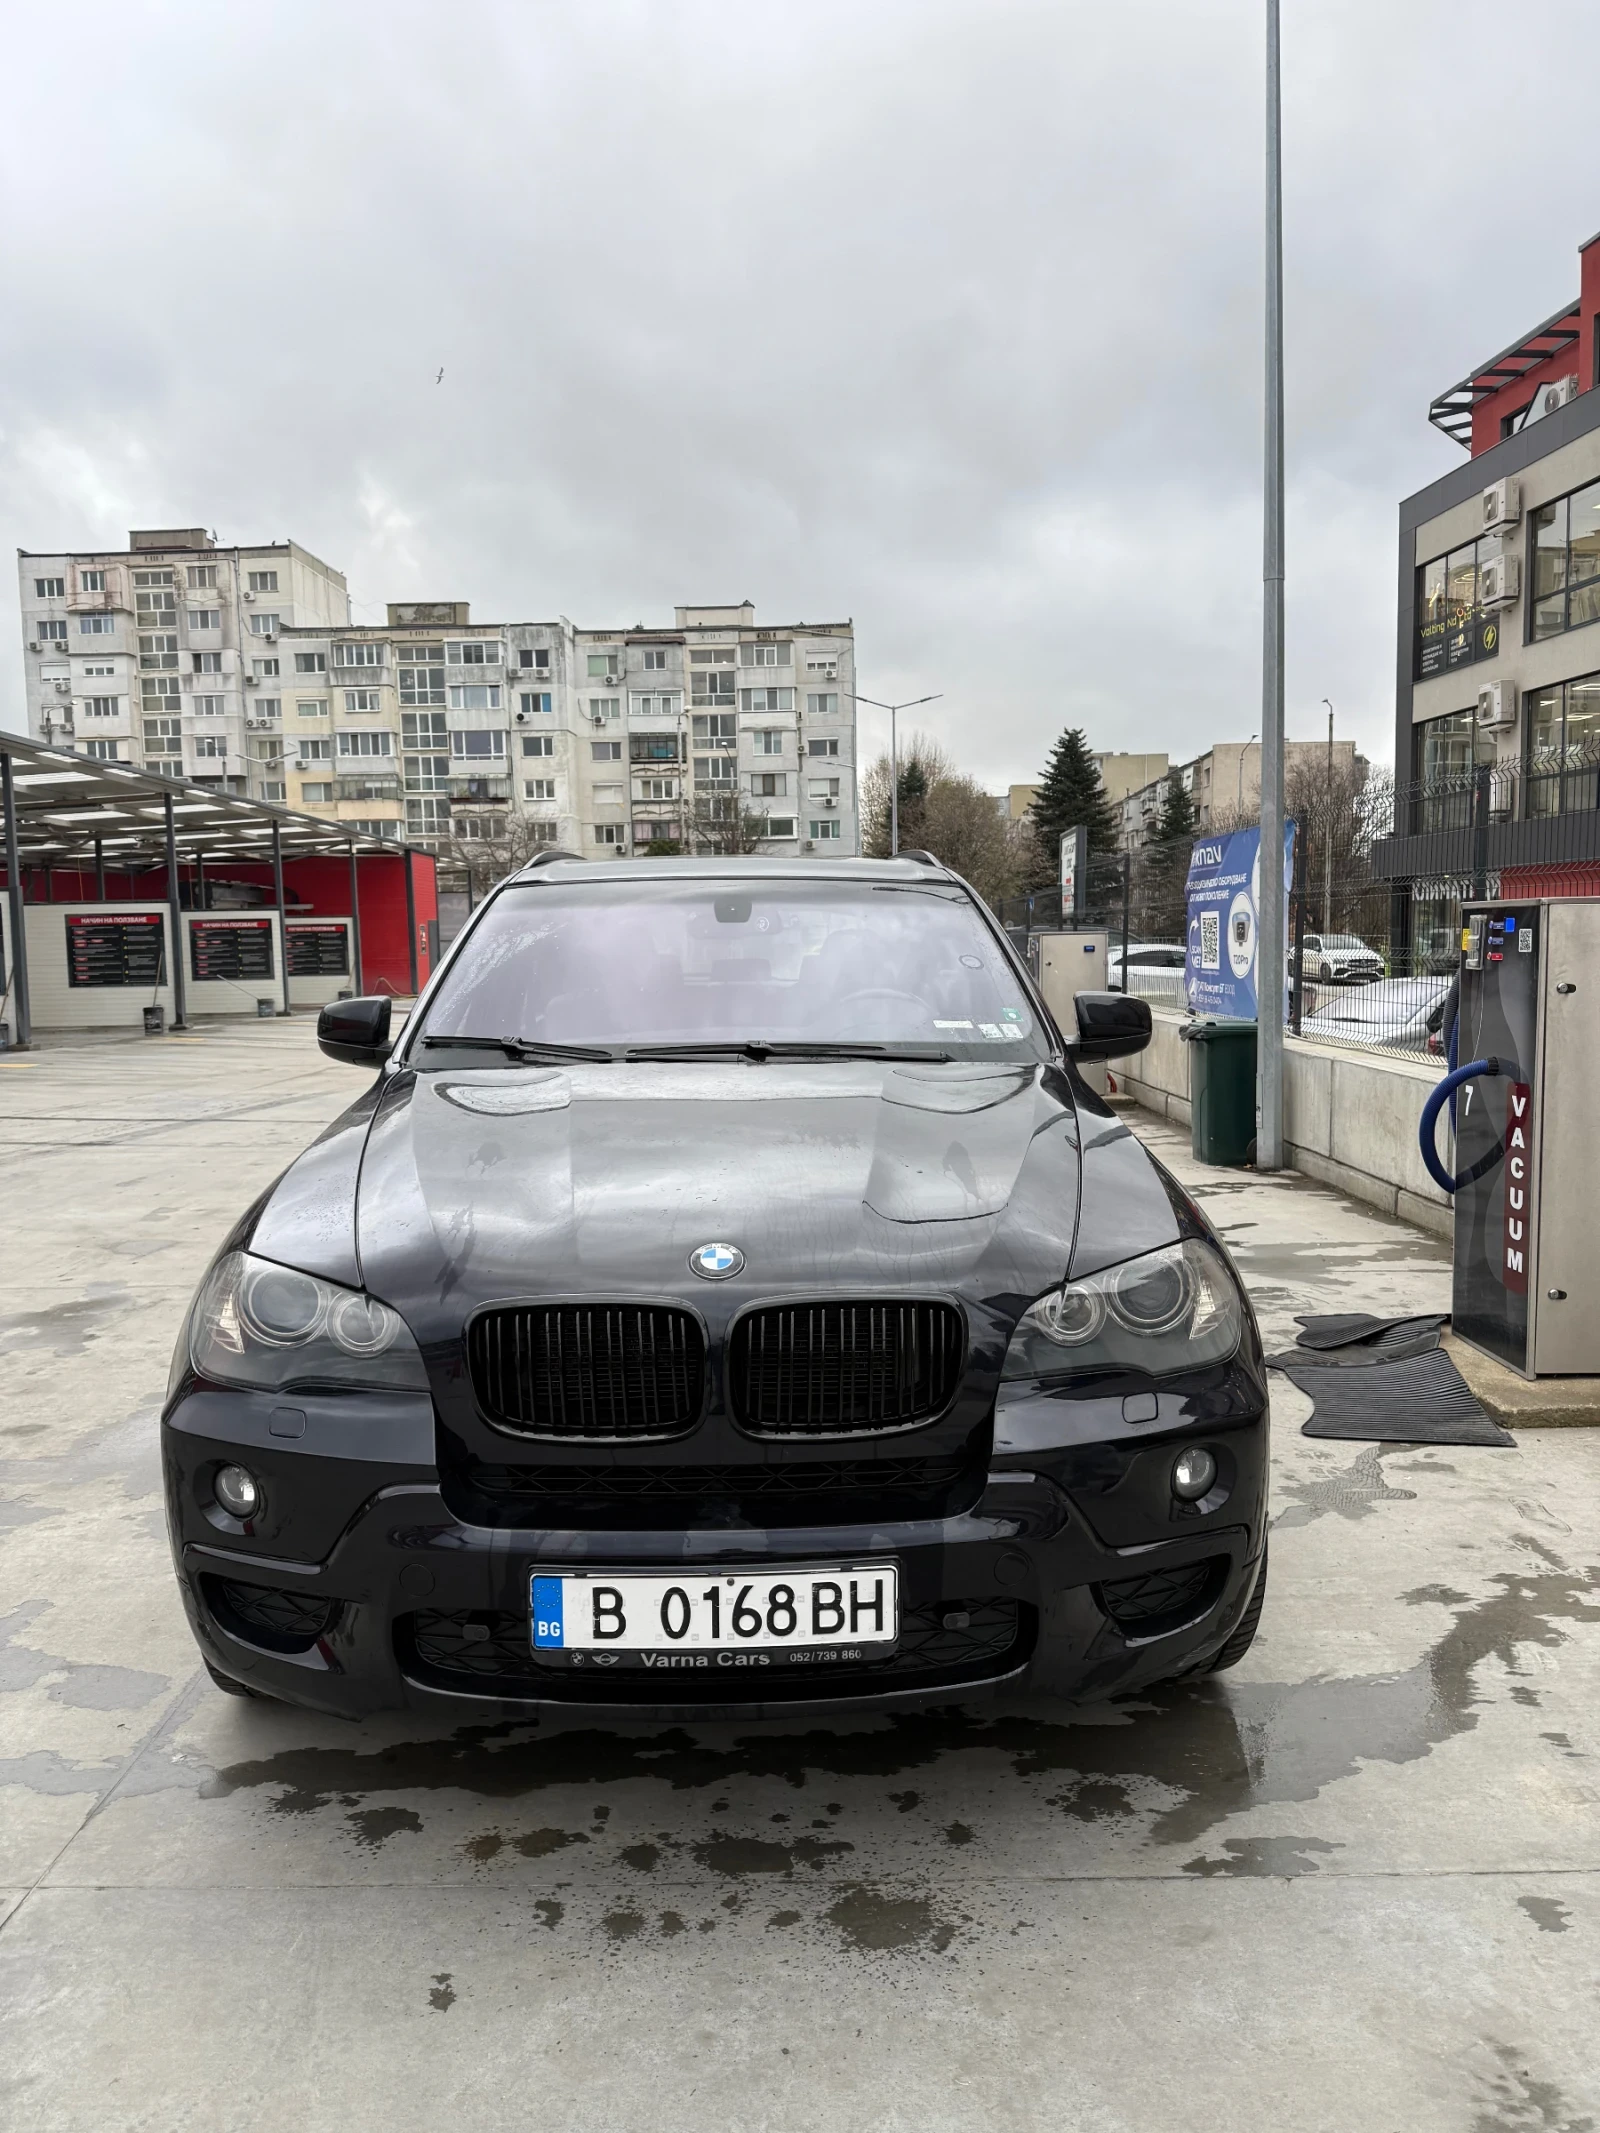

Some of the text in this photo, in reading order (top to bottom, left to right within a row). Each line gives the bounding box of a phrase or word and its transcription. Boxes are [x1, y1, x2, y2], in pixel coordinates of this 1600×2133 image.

[1465, 1085, 1474, 1116] 7
[1507, 1095, 1527, 1273] VACUUM
[592, 1579, 883, 1639] B 0168 BH
[538, 1621, 561, 1637] BG
[640, 1652, 708, 1668] Varna
[717, 1652, 771, 1667] Cars
[841, 1650, 862, 1660] 860
